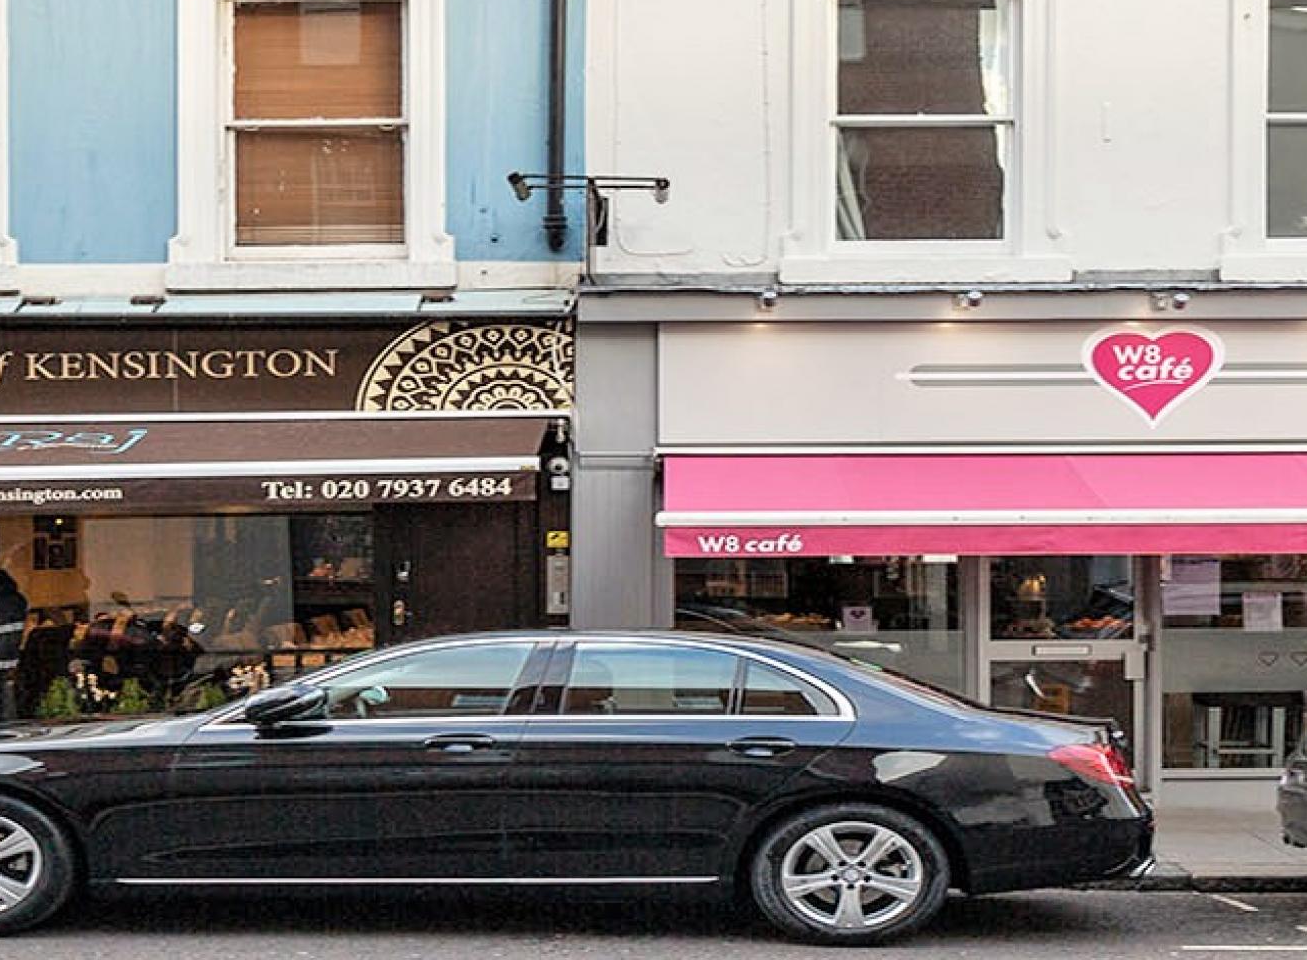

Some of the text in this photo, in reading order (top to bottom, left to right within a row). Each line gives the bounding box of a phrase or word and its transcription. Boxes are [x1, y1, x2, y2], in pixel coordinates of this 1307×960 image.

[24, 348, 340, 380] KENSINGTON
[1112, 344, 1161, 365] W8
[1117, 356, 1194, 381] café
[261, 477, 512, 499] Tel: 020 7937 6484
[698, 534, 803, 553] W8 café
